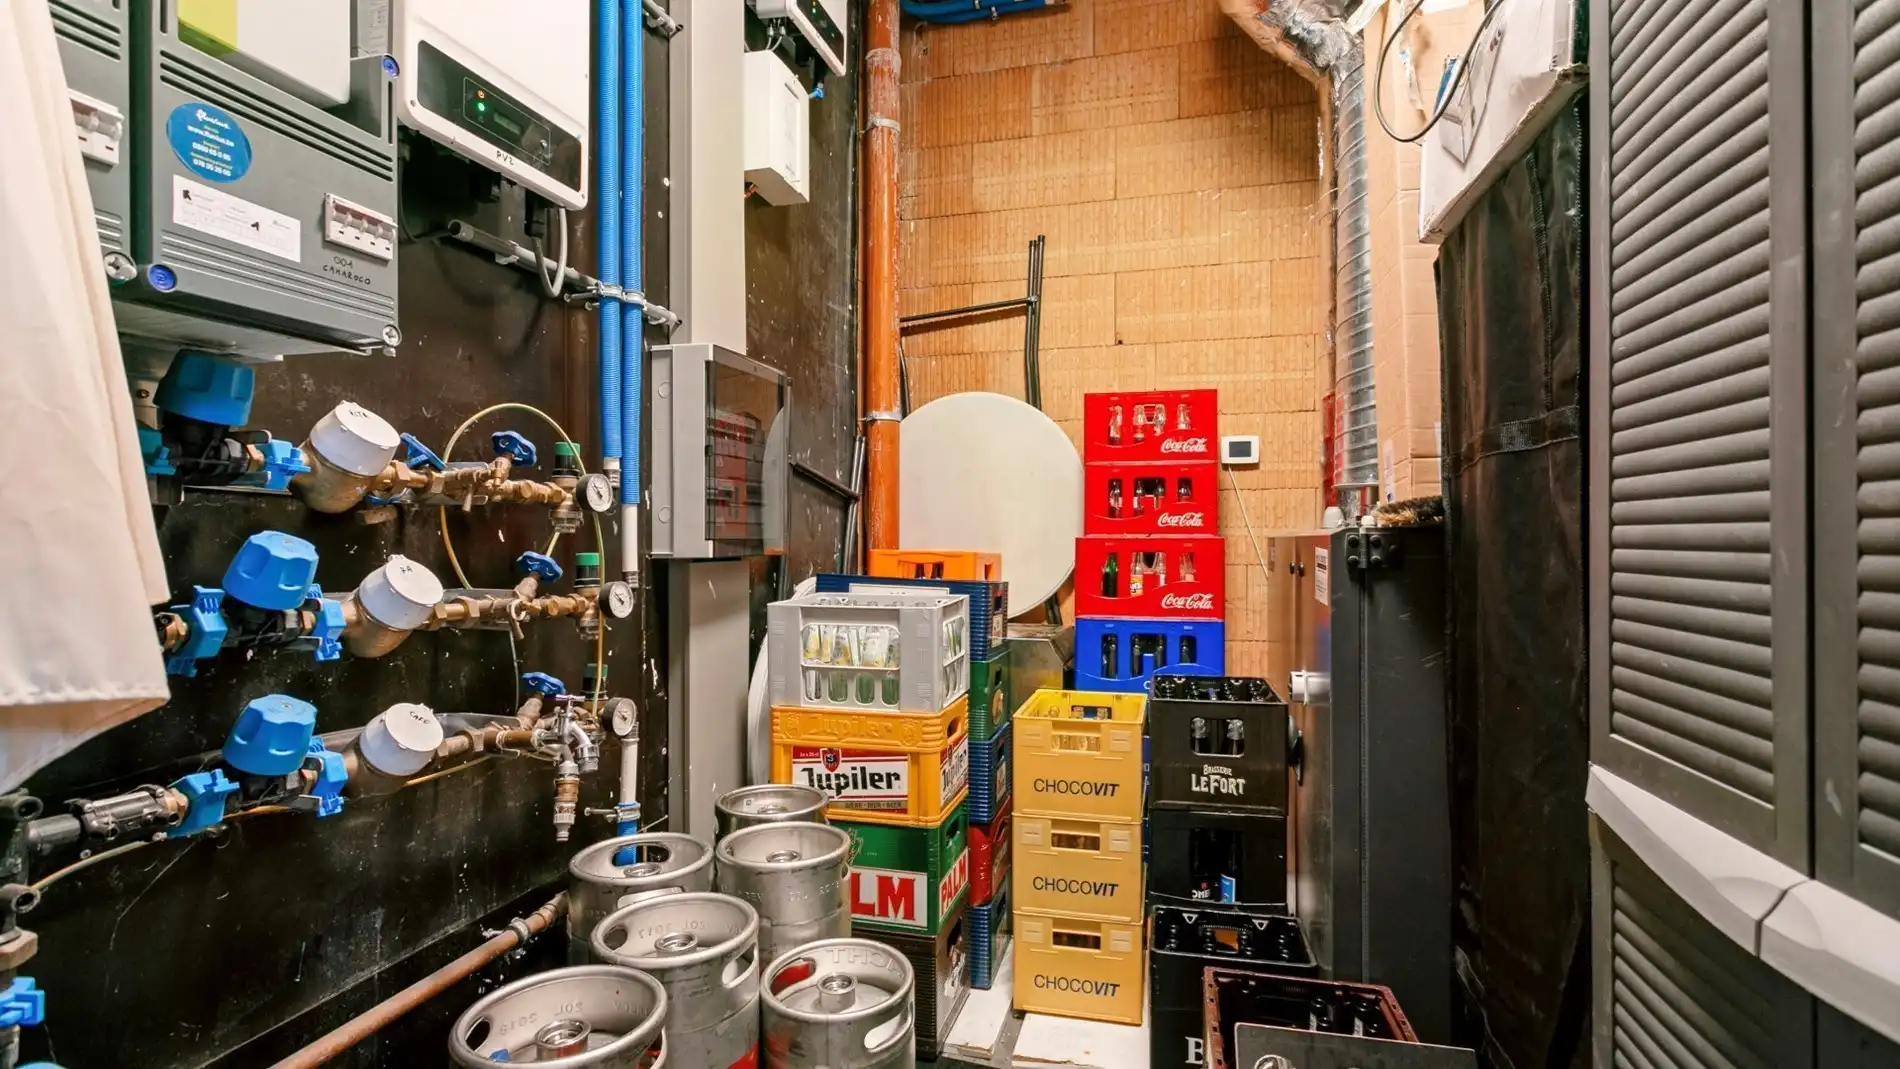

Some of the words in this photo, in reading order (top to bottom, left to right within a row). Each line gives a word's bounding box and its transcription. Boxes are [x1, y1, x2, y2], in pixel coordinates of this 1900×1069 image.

[1160, 437, 1208, 453] Coca-Cola
[1157, 512, 1204, 527] Coca-Cola
[1161, 592, 1214, 609] Coca-Cola
[801, 715, 893, 739] Jupiler
[800, 766, 902, 798] Jupiler
[1033, 778, 1120, 797] CHOCOVIT
[850, 871, 916, 921] LM
[941, 852, 967, 918] PALM
[1032, 876, 1119, 897] CHOCOVIT
[1033, 974, 1121, 997] CHOCOVIT
